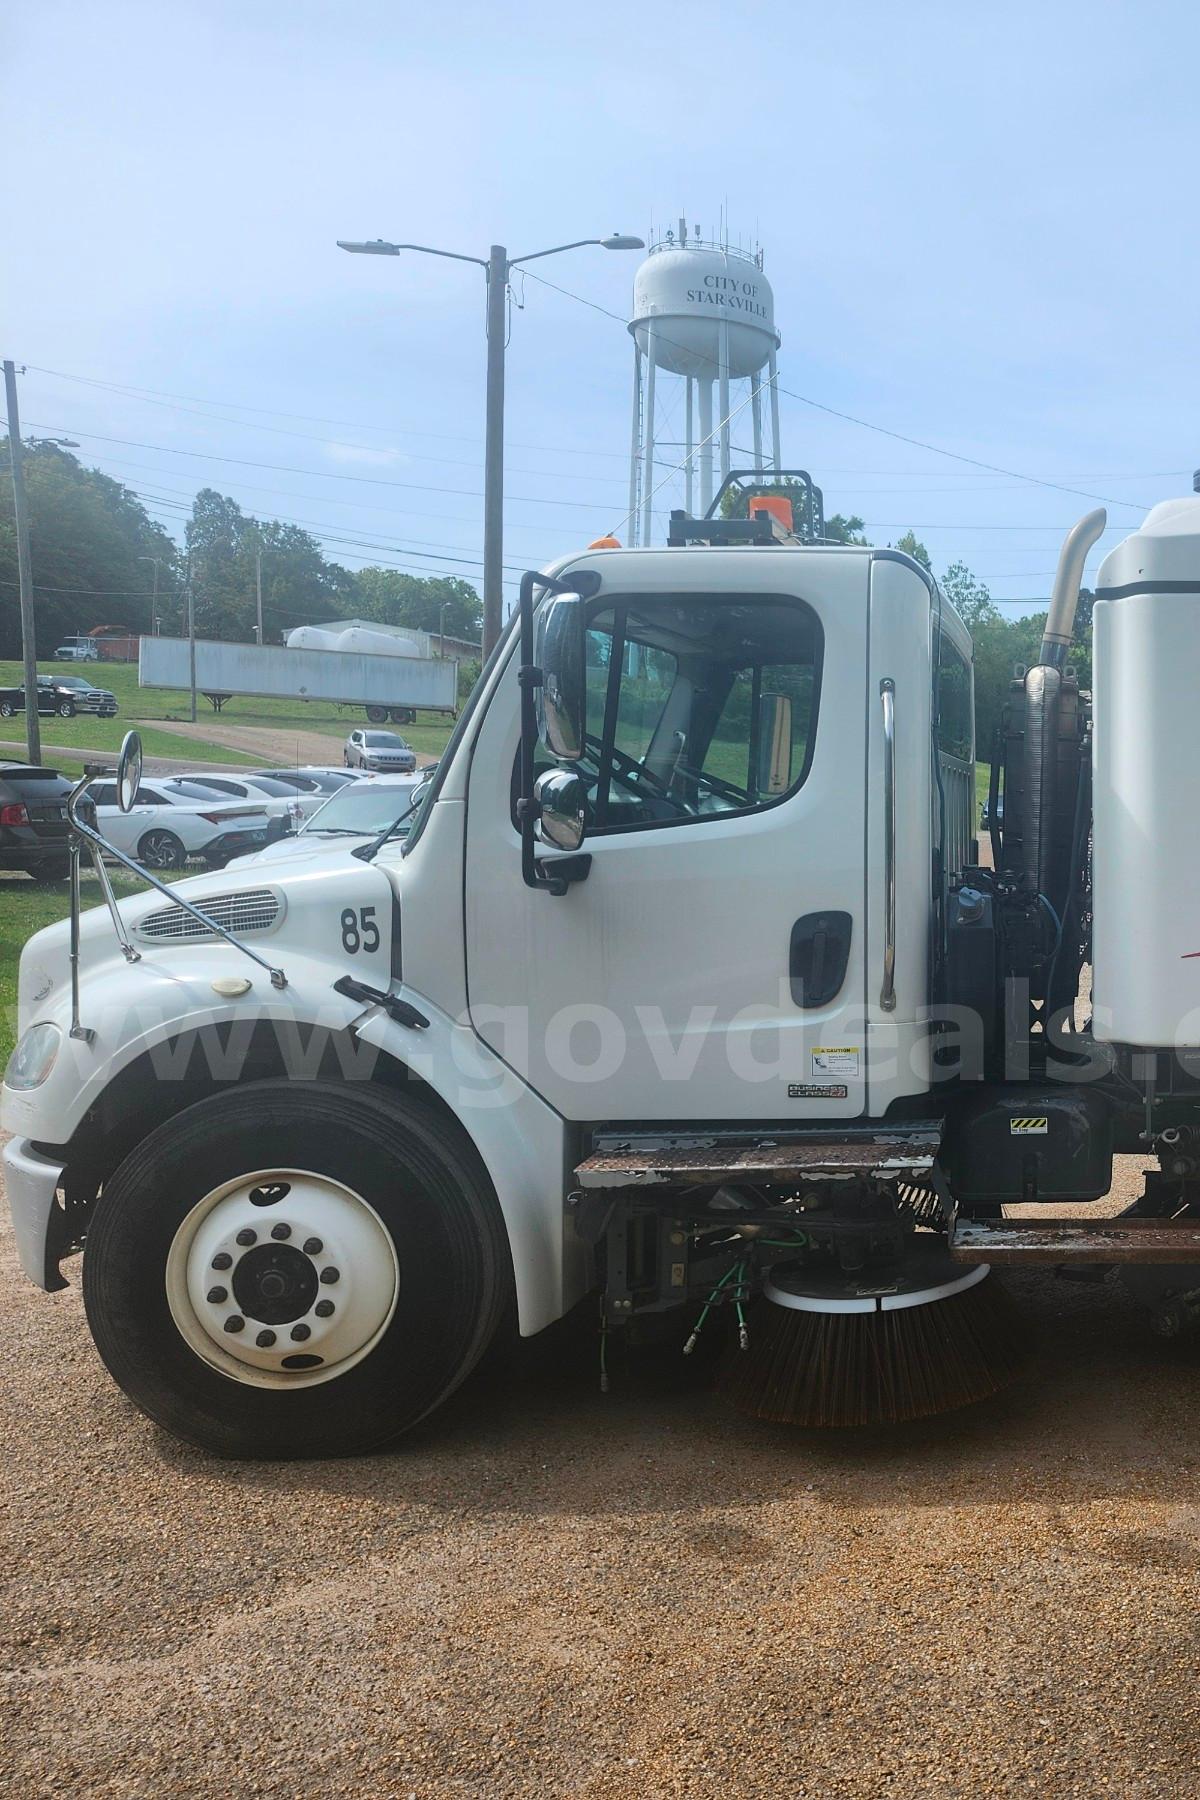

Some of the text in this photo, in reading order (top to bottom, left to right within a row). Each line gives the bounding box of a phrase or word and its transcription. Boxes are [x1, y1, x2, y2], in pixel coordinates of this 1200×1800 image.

[703, 275, 759, 297] CITY OF
[340, 906, 380, 955] 85
